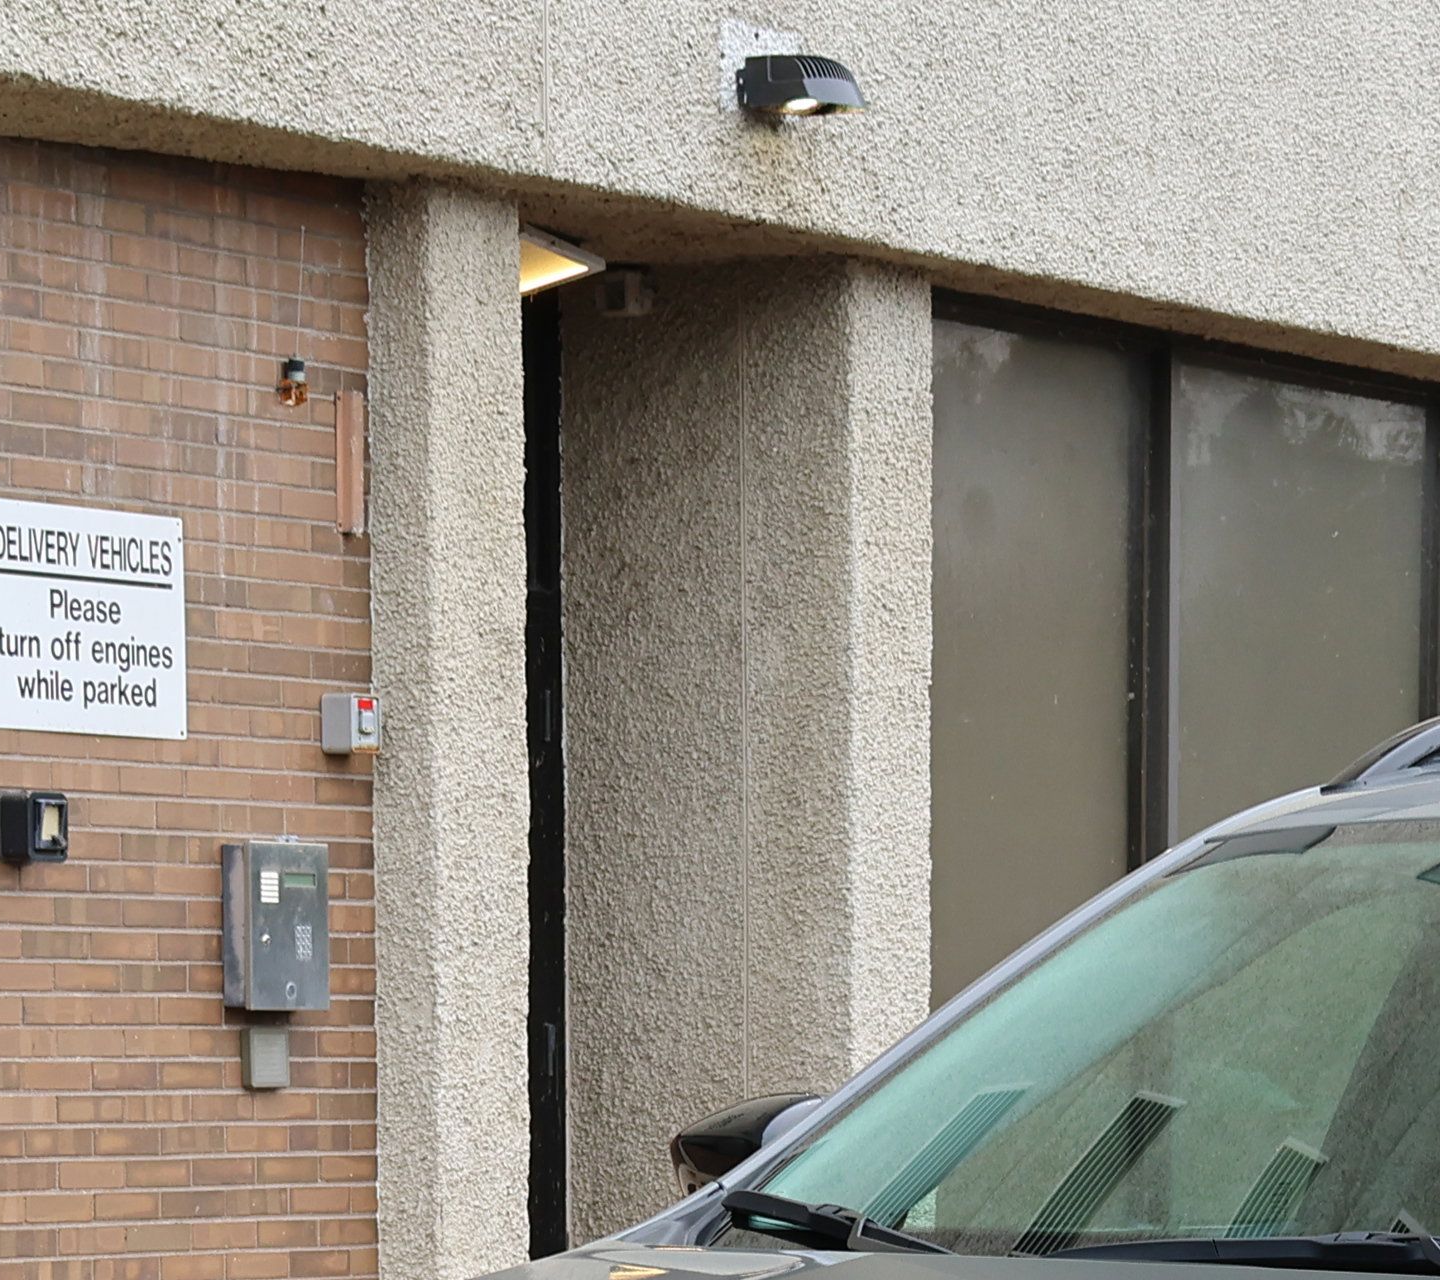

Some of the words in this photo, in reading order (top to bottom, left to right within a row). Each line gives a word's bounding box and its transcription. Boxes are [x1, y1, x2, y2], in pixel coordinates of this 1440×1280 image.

[87, 533, 173, 577] VEHICLES
[49, 588, 122, 625] Please
[50, 631, 82, 662] off
[91, 636, 174, 673] engines
[17, 669, 74, 702] while
[83, 675, 158, 710] parked
